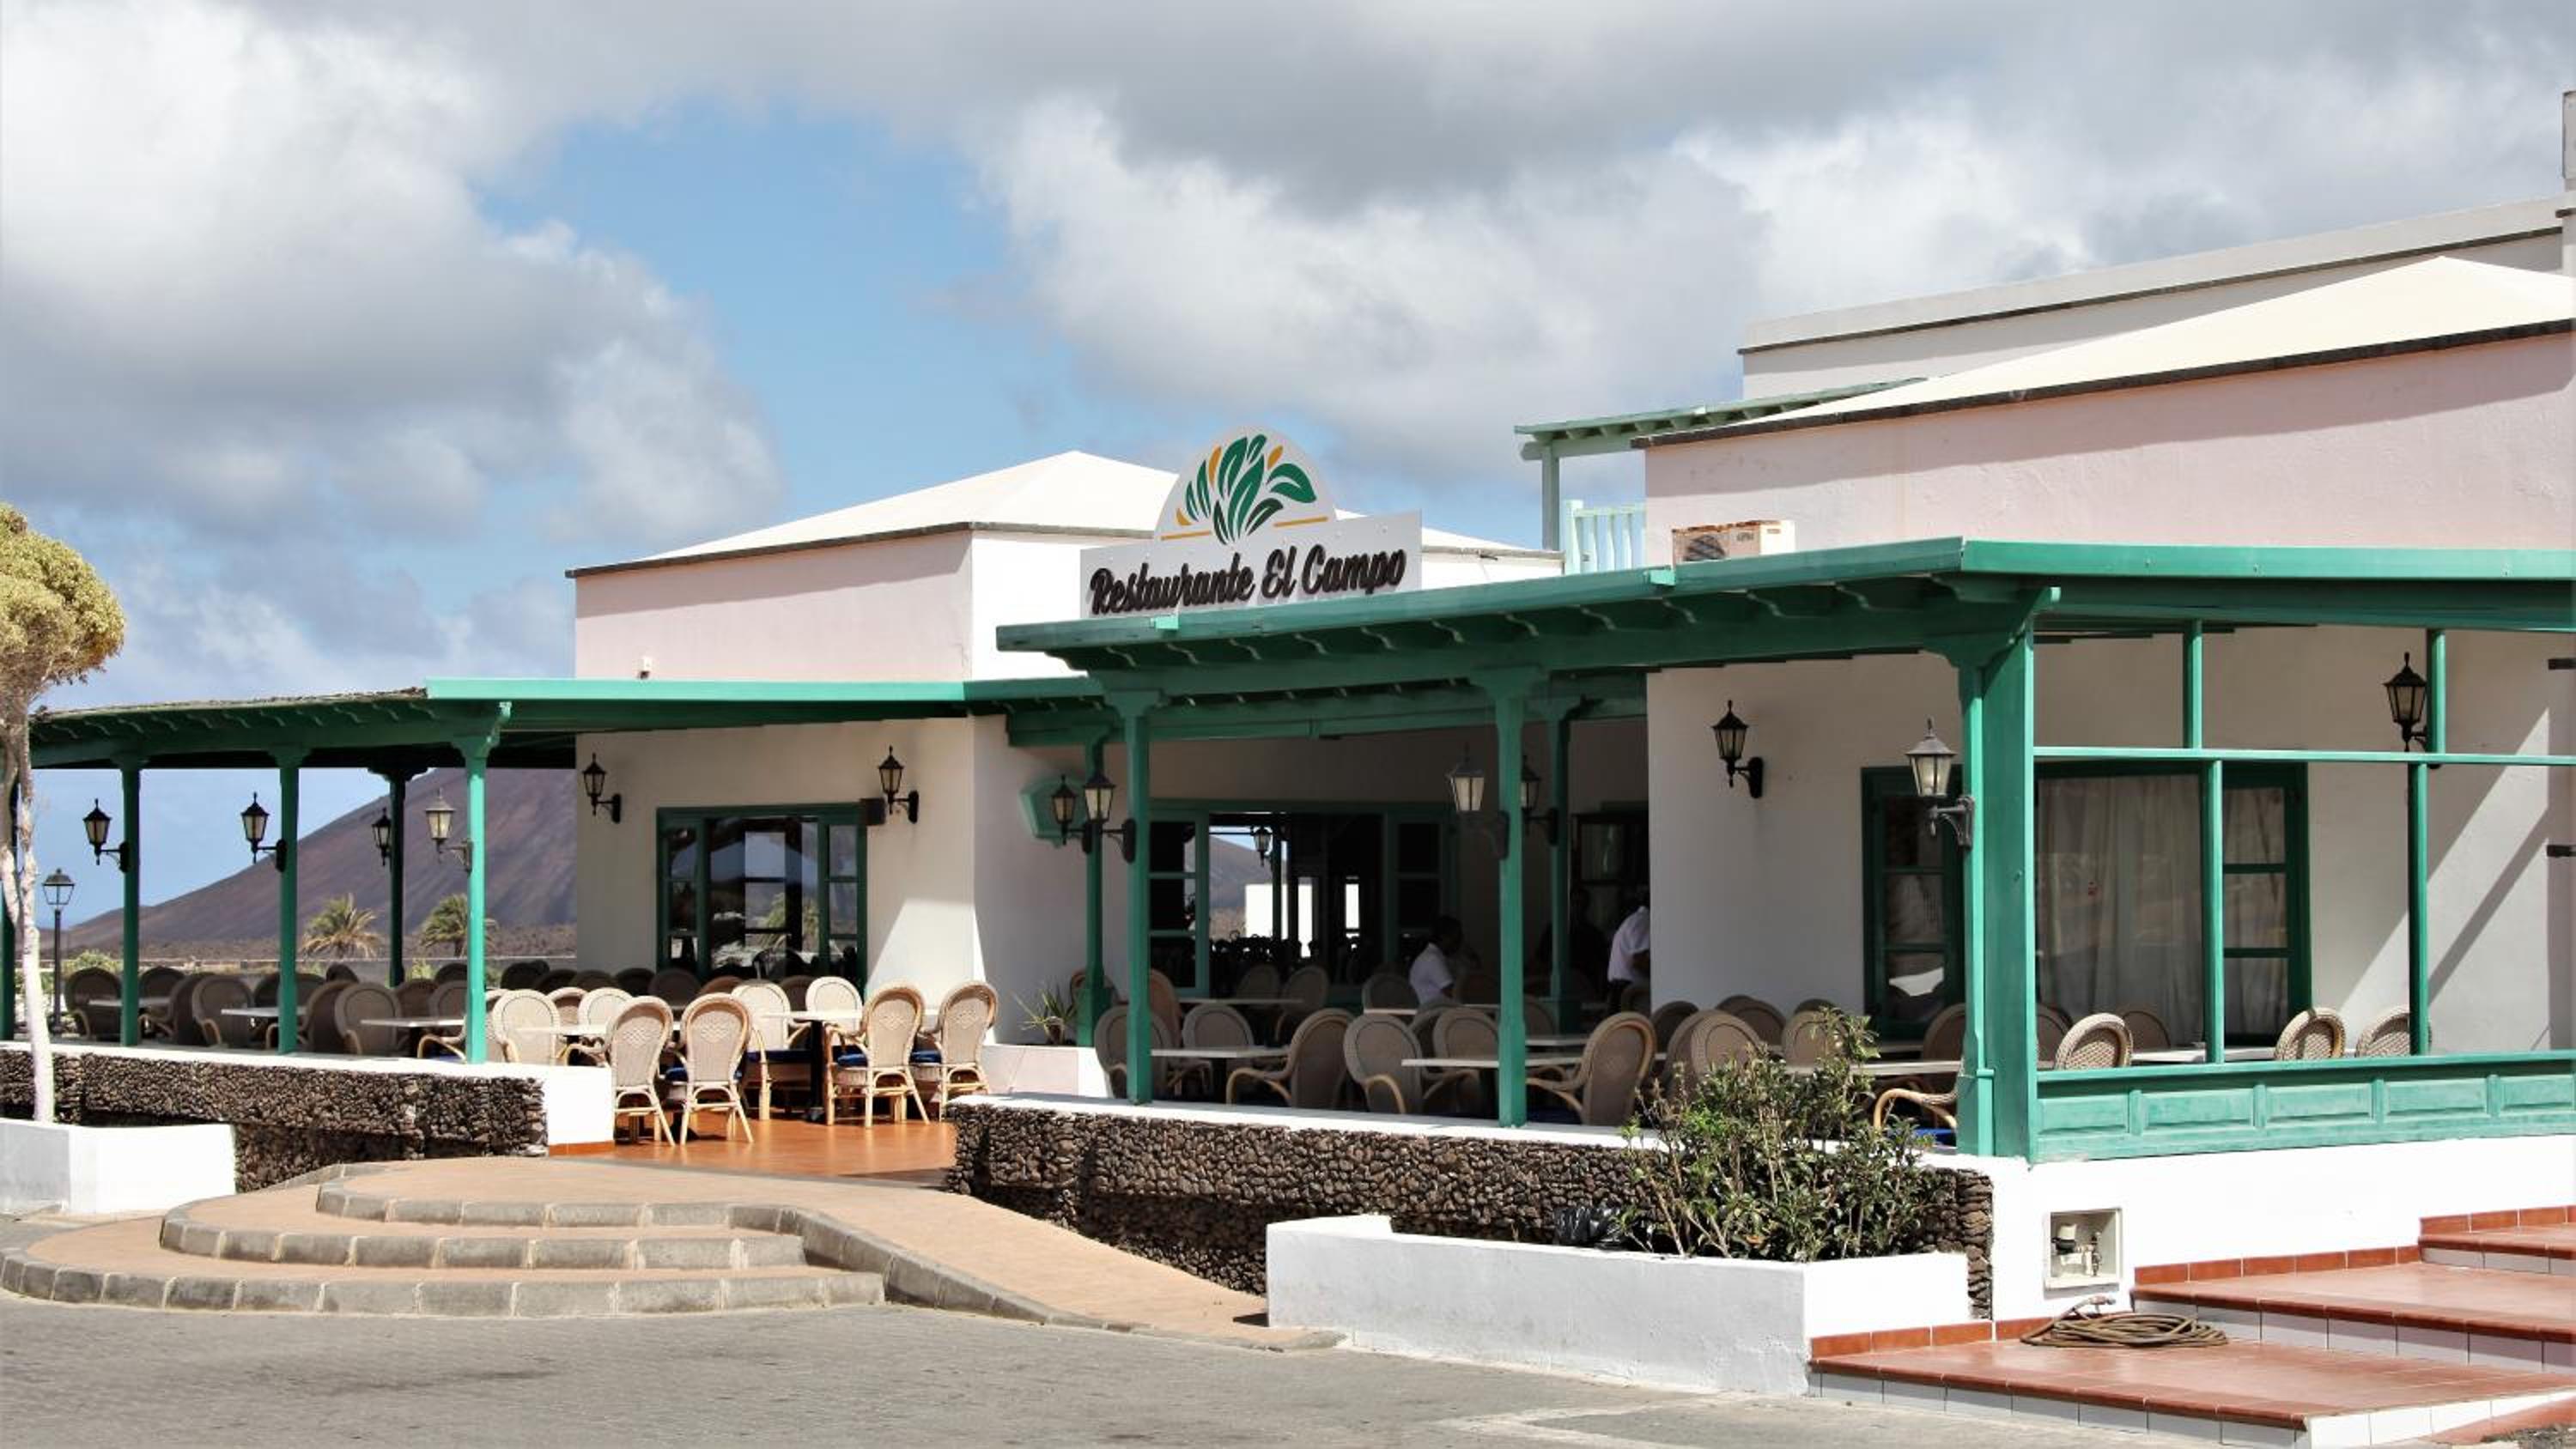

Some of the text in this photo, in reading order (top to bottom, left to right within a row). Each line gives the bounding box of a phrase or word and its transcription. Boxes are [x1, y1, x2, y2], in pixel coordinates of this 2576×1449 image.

[1090, 544, 1406, 615] Restaurante El Campo
